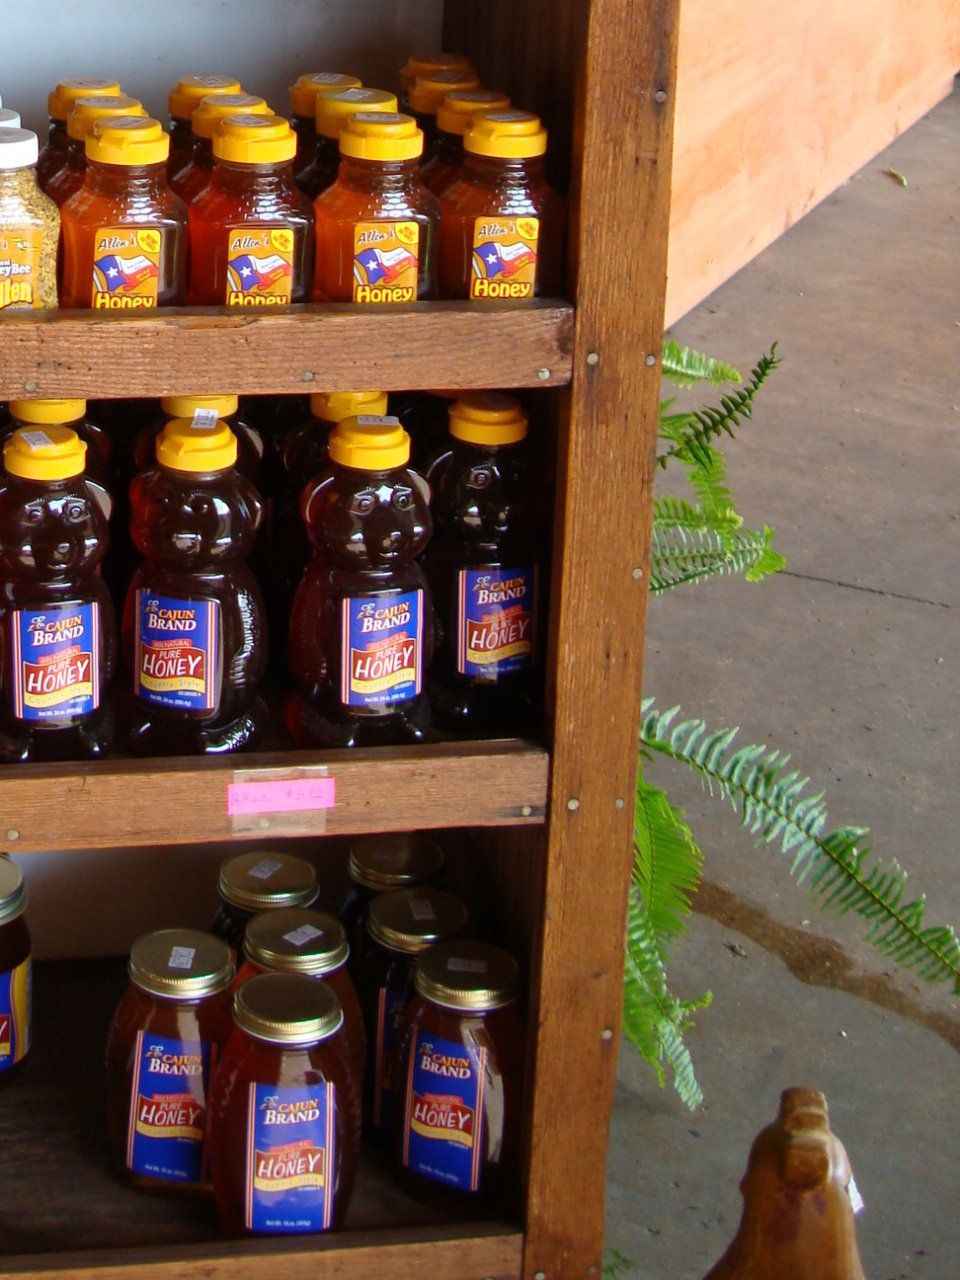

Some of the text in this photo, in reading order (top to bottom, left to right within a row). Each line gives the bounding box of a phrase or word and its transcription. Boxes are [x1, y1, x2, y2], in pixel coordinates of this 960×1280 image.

[98, 232, 137, 251] Allen's
[356, 284, 413, 303] Honey
[473, 277, 531, 298] Honey
[96, 291, 154, 308] Honey
[490, 577, 526, 592] CAJUN
[477, 586, 526, 605] BRAND
[159, 609, 195, 620] CAJUN
[375, 602, 409, 619] CAJUN
[45, 615, 83, 632] CAJUN
[148, 614, 197, 631] BRAND
[361, 612, 411, 633] BRAND
[33, 625, 84, 646] BRAND
[471, 619, 529, 649] HONEY
[143, 654, 202, 677] HONEY
[355, 645, 414, 678] HONEY
[27, 658, 90, 692] HONEY
[149, 1058, 203, 1075] BRAND
[162, 1054, 202, 1065] CAJUN
[421, 1055, 471, 1079] BRAND
[432, 1053, 470, 1068] CAJUN
[140, 1105, 200, 1126] HONEY
[278, 1099, 318, 1113] CAJUN
[264, 1109, 320, 1125] BRAND
[414, 1103, 470, 1130] HONEY
[258, 1153, 321, 1178] HONEY
